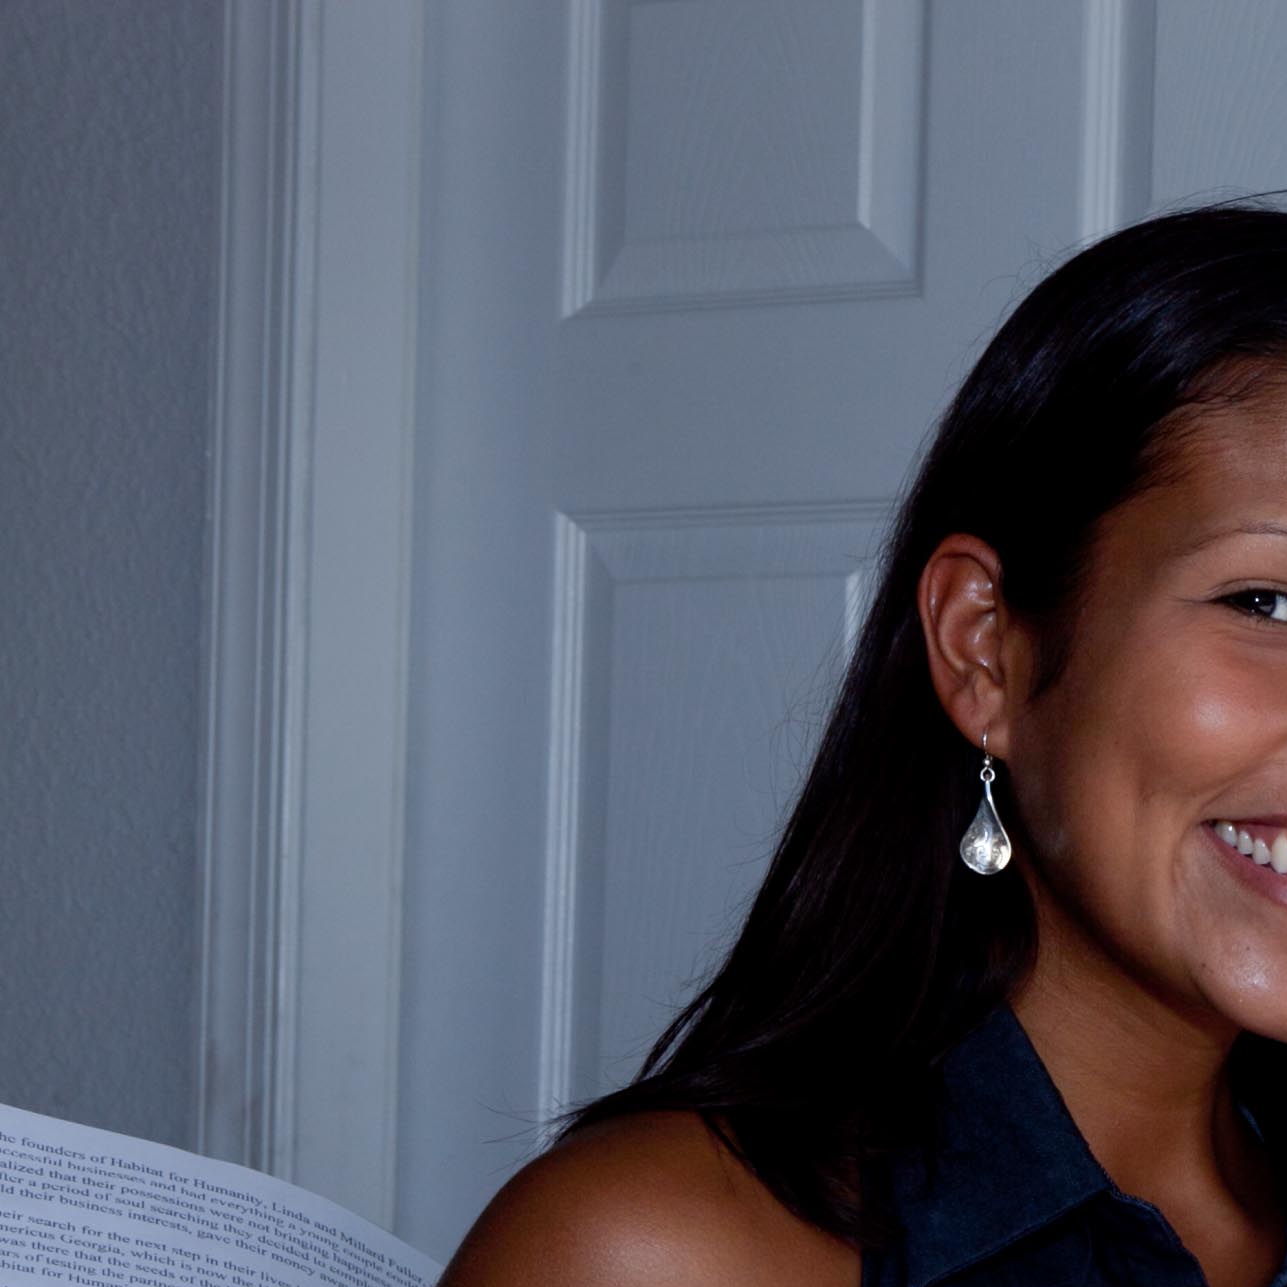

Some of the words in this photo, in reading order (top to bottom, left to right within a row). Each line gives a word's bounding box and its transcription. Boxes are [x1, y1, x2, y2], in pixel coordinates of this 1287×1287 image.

[0, 1147, 63, 1167] ccessful
[67, 1160, 145, 1185] businesses
[150, 1180, 176, 1192] and
[180, 1185, 206, 1200] had
[209, 1195, 284, 1228] everything
[287, 1222, 296, 1230] a
[300, 1227, 339, 1252] young
[19, 1186, 55, 1202] their
[59, 1194, 123, 1217] business
[127, 1210, 192, 1235] interests,
[196, 1229, 231, 1244] gave
[234, 1237, 268, 1257] their
[270, 1253, 315, 1278] money
[21, 1136, 86, 1160] founders
[90, 1155, 107, 1165] of
[111, 1158, 164, 1178] Habitat
[169, 1171, 190, 1185] for
[194, 1178, 268, 1210] Humanity,
[272, 1202, 310, 1225] Linda
[313, 1221, 337, 1237] and
[340, 1232, 385, 1262] Millard
[28, 1178, 37, 1186] a
[41, 1181, 90, 1197] period
[94, 1192, 112, 1202] of
[115, 1197, 145, 1209] soul
[150, 1205, 220, 1231] searching
[223, 1221, 252, 1241] they
[256, 1232, 309, 1260] decided
[312, 1254, 326, 1268] to
[49, 1168, 76, 1182] that
[82, 1175, 117, 1191] their
[120, 1186, 206, 1212] possessions
[209, 1208, 245, 1224] were
[248, 1220, 270, 1233] not
[274, 1227, 330, 1260] bringing
[0, 1210, 23, 1221] eir
[27, 1215, 76, 1231] search
[81, 1224, 104, 1238] for
[107, 1230, 131, 1243] the
[135, 1238, 166, 1252] next
[171, 1247, 201, 1263] step
[205, 1254, 219, 1265] in
[222, 1258, 258, 1278] their
[0, 1260, 35, 1274] bitat
[41, 1266, 64, 1279] for
[24, 1253, 43, 1263] of
[46, 1255, 97, 1277] testing
[101, 1267, 125, 1280] the
[31, 1239, 69, 1255] there
[74, 1248, 103, 1263] that
[107, 1255, 130, 1268] the
[135, 1264, 175, 1279] seeds
[179, 1274, 195, 1284] of
[59, 1233, 125, 1256] Georgia,
[130, 1250, 176, 1266] which
[180, 1260, 192, 1271] is
[195, 1266, 227, 1280] now
